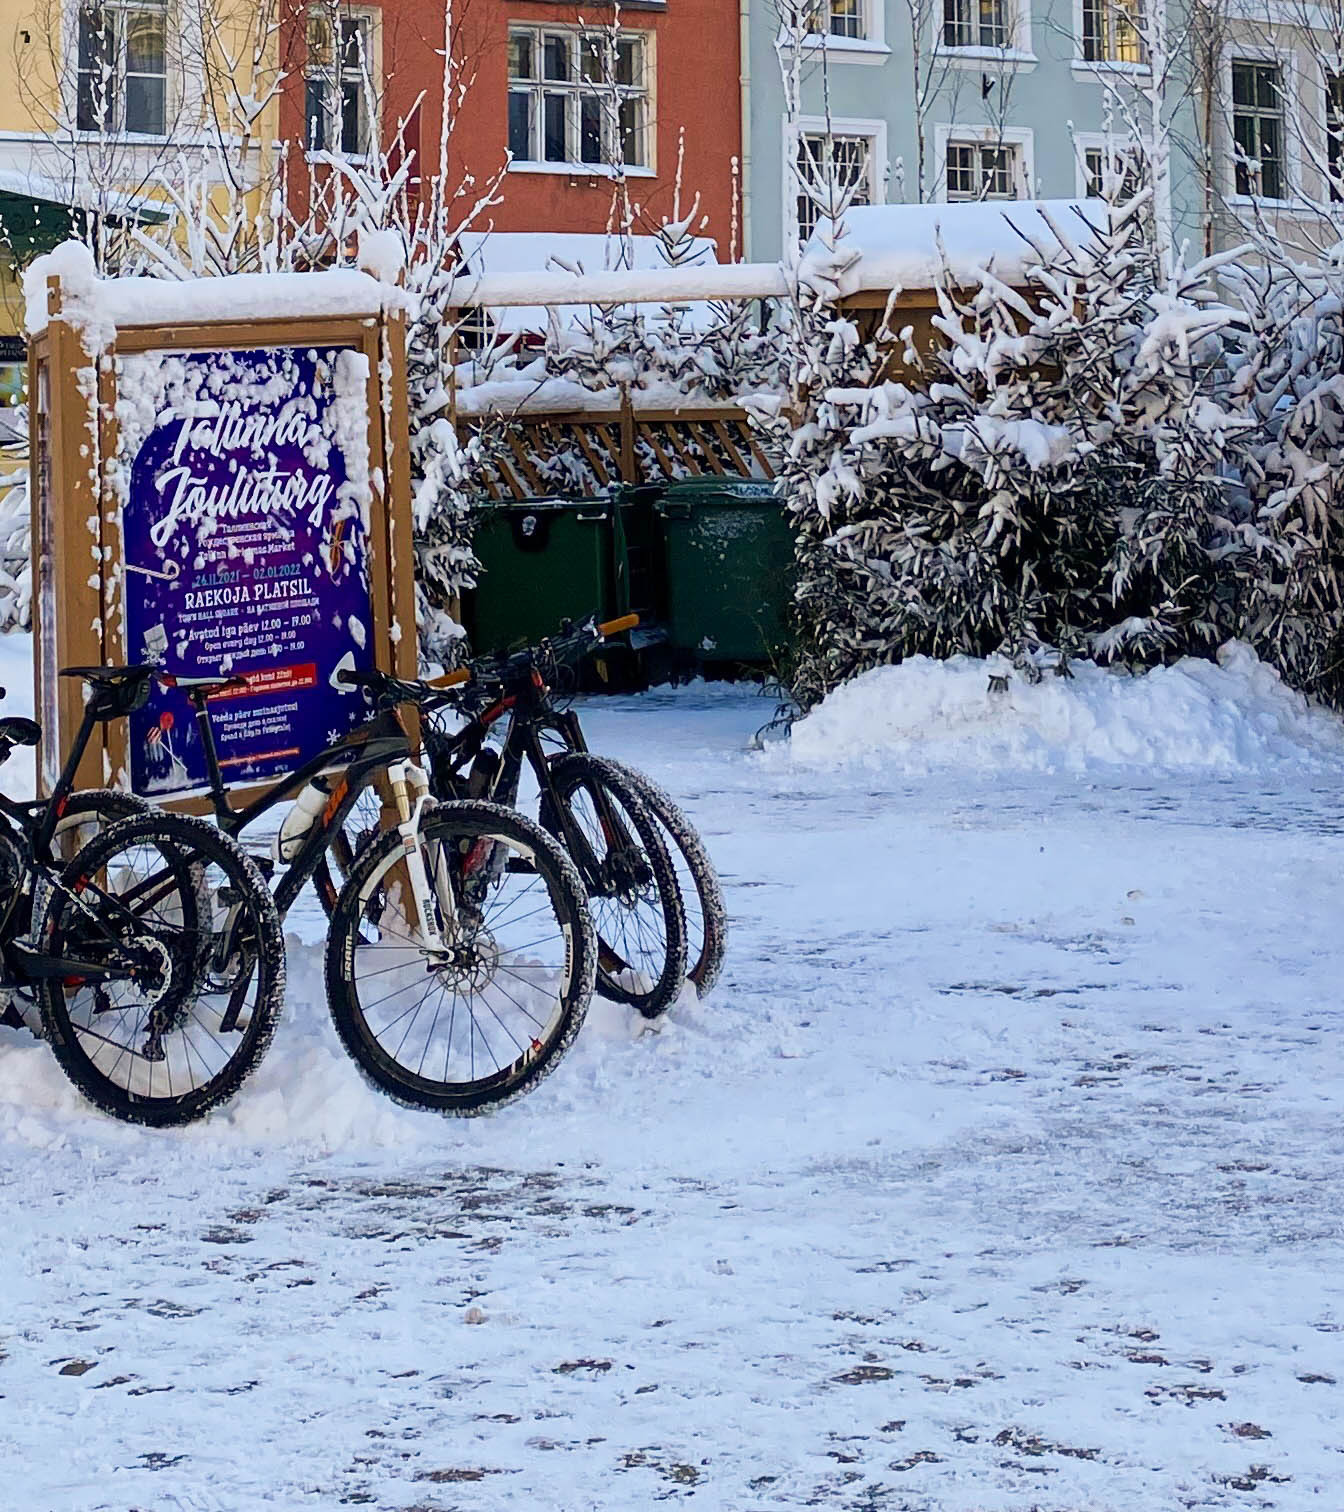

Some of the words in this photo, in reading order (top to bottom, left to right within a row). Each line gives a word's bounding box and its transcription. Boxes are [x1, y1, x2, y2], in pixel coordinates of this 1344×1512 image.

[150, 466, 335, 547] Jõuluturg
[253, 563, 301, 580] 02.01.2022
[185, 585, 250, 609] RAEKOJA
[254, 577, 312, 601] PLATSIL
[189, 626, 220, 641] Avatud
